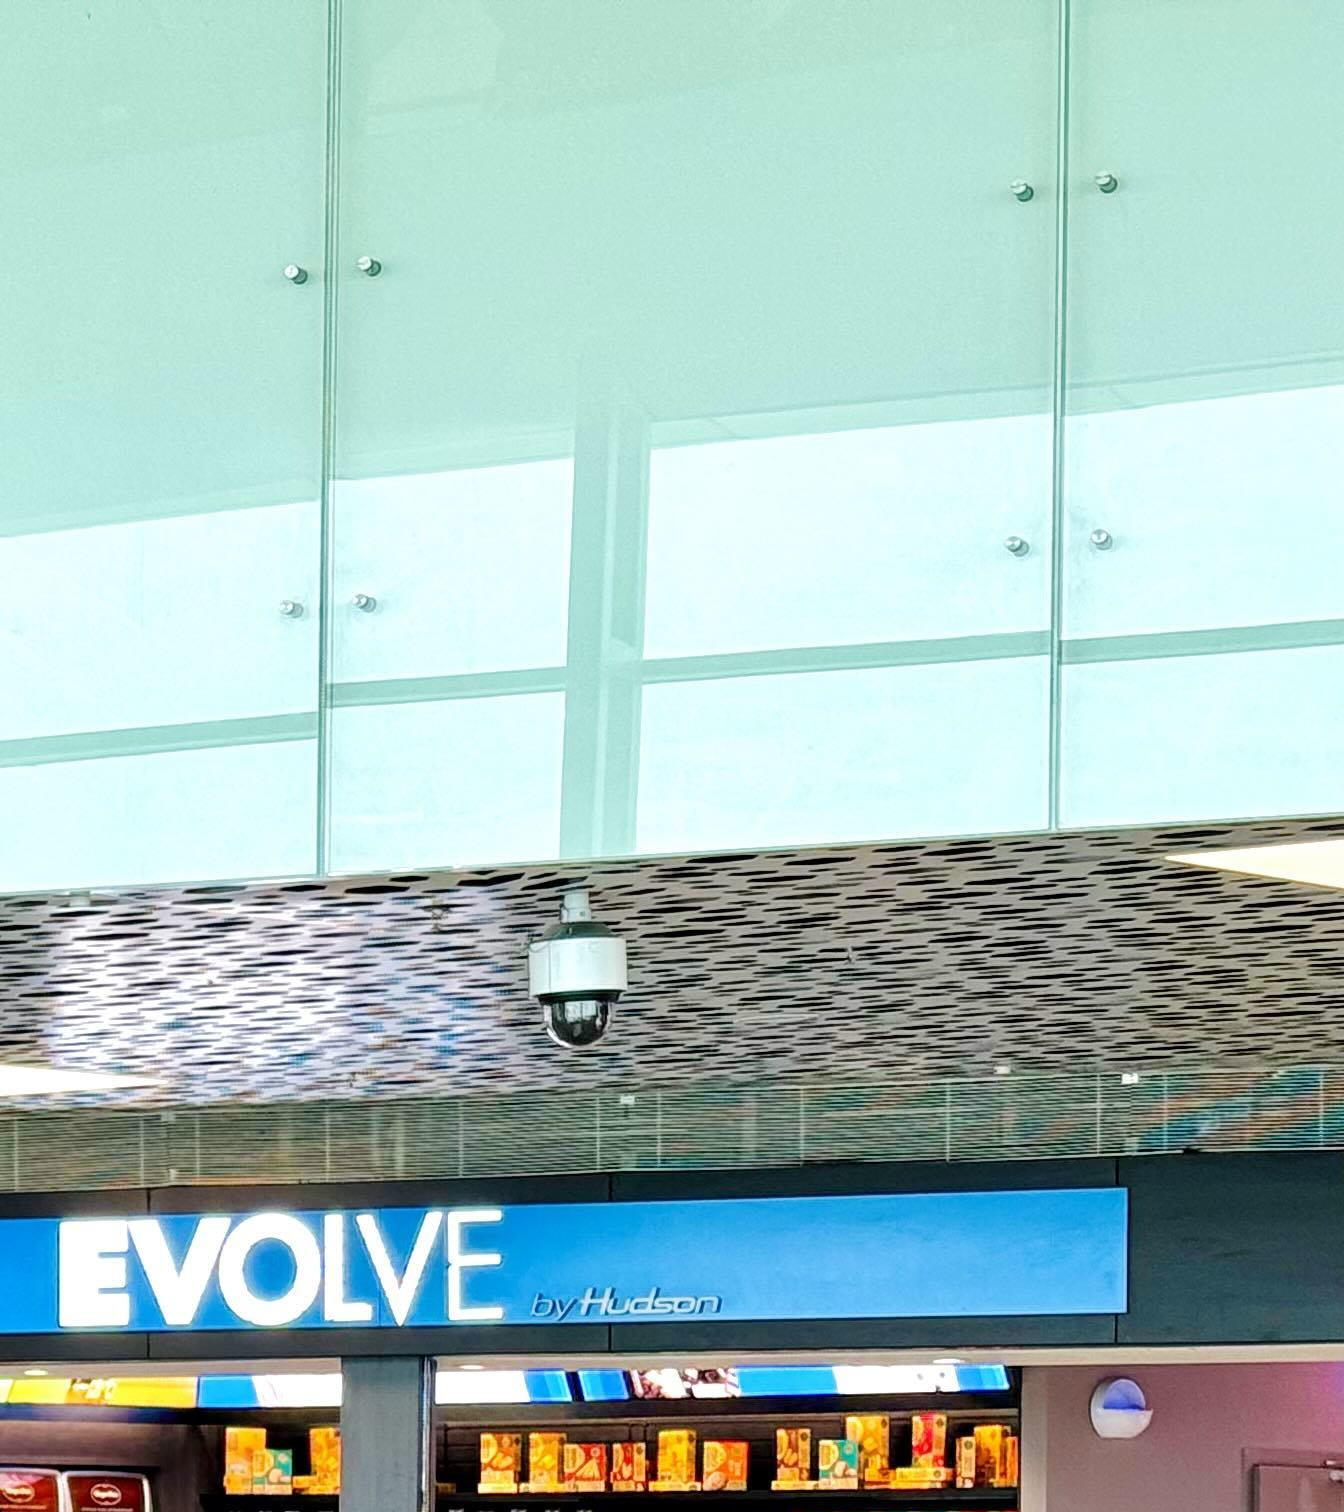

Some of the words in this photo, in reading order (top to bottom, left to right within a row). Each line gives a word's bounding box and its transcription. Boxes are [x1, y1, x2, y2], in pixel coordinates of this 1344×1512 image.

[58, 1209, 504, 1328] EVOLVE
[531, 1292, 577, 1321] by
[579, 1286, 723, 1316] Hudson
